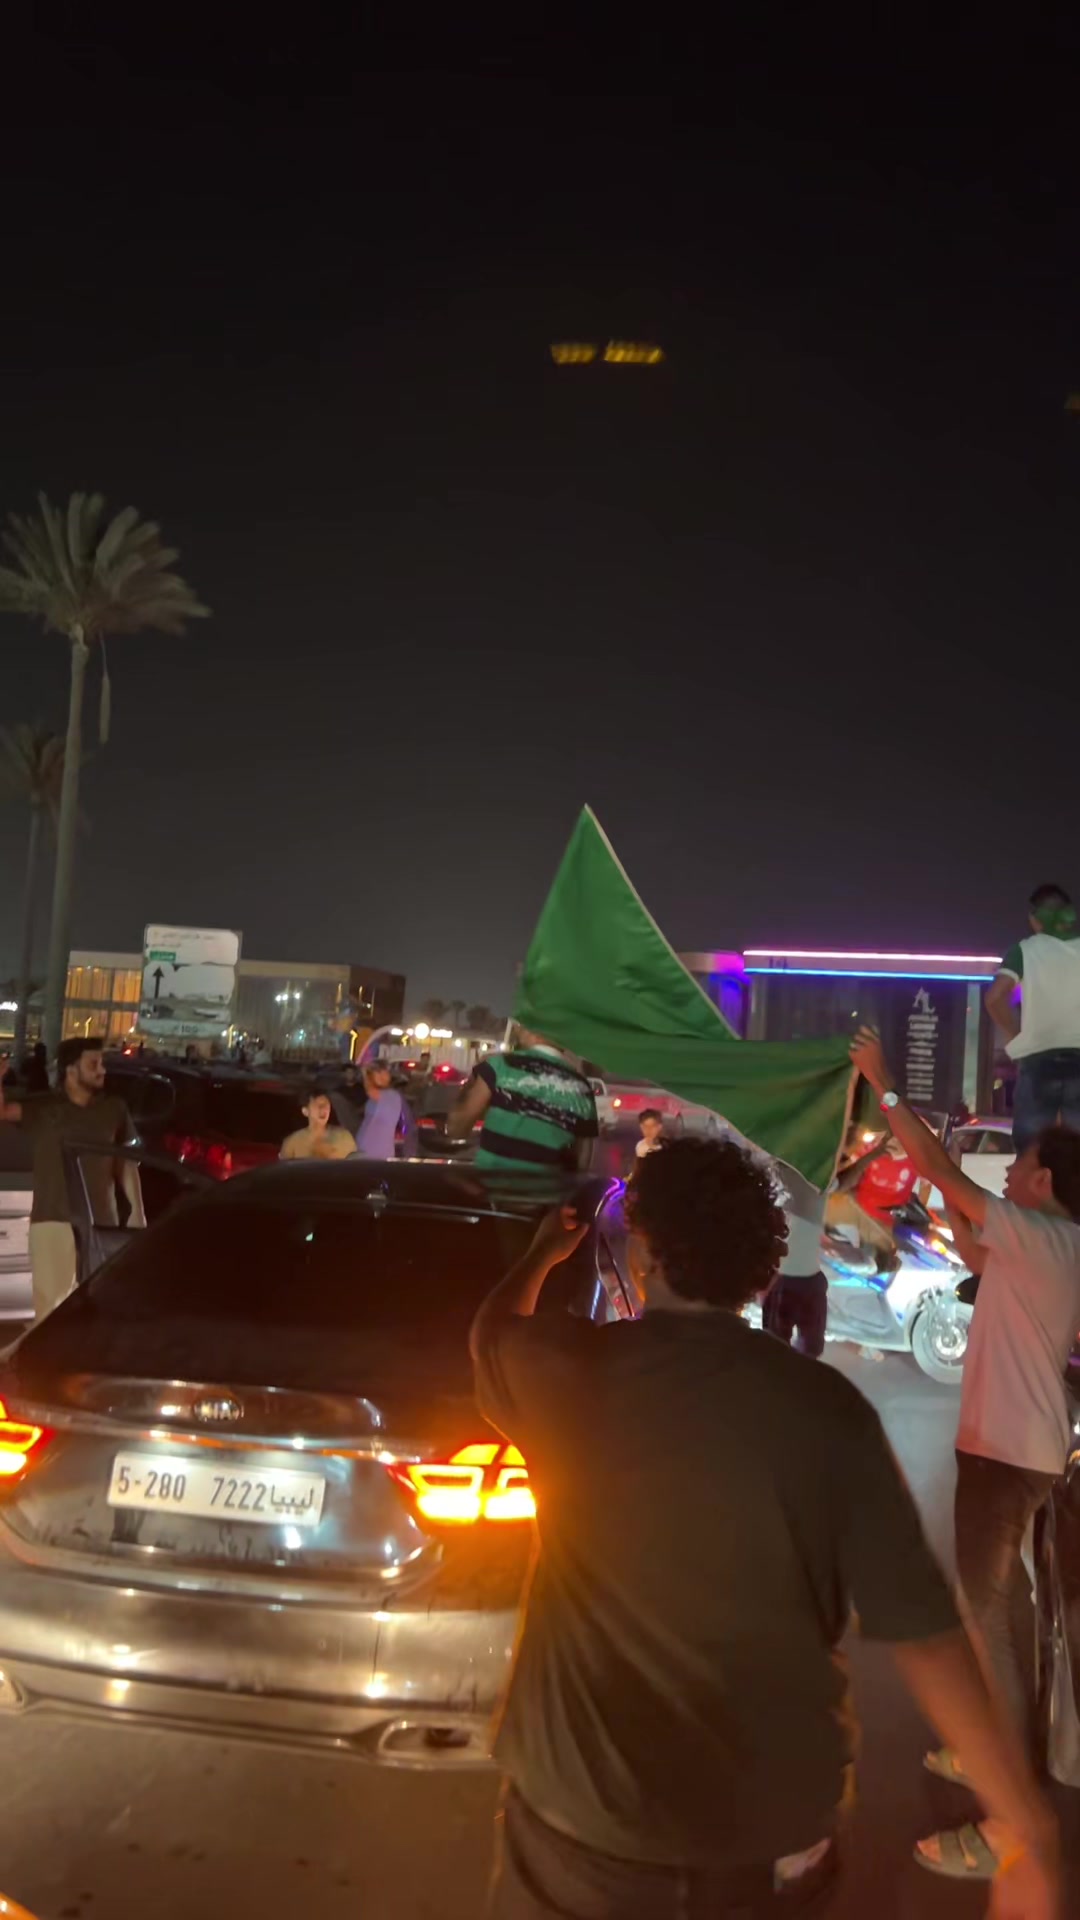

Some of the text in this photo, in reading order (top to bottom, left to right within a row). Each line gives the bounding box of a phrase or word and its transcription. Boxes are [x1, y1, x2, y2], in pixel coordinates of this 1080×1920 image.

[118, 1466, 315, 1516] 5-280 7222 ليبيا
